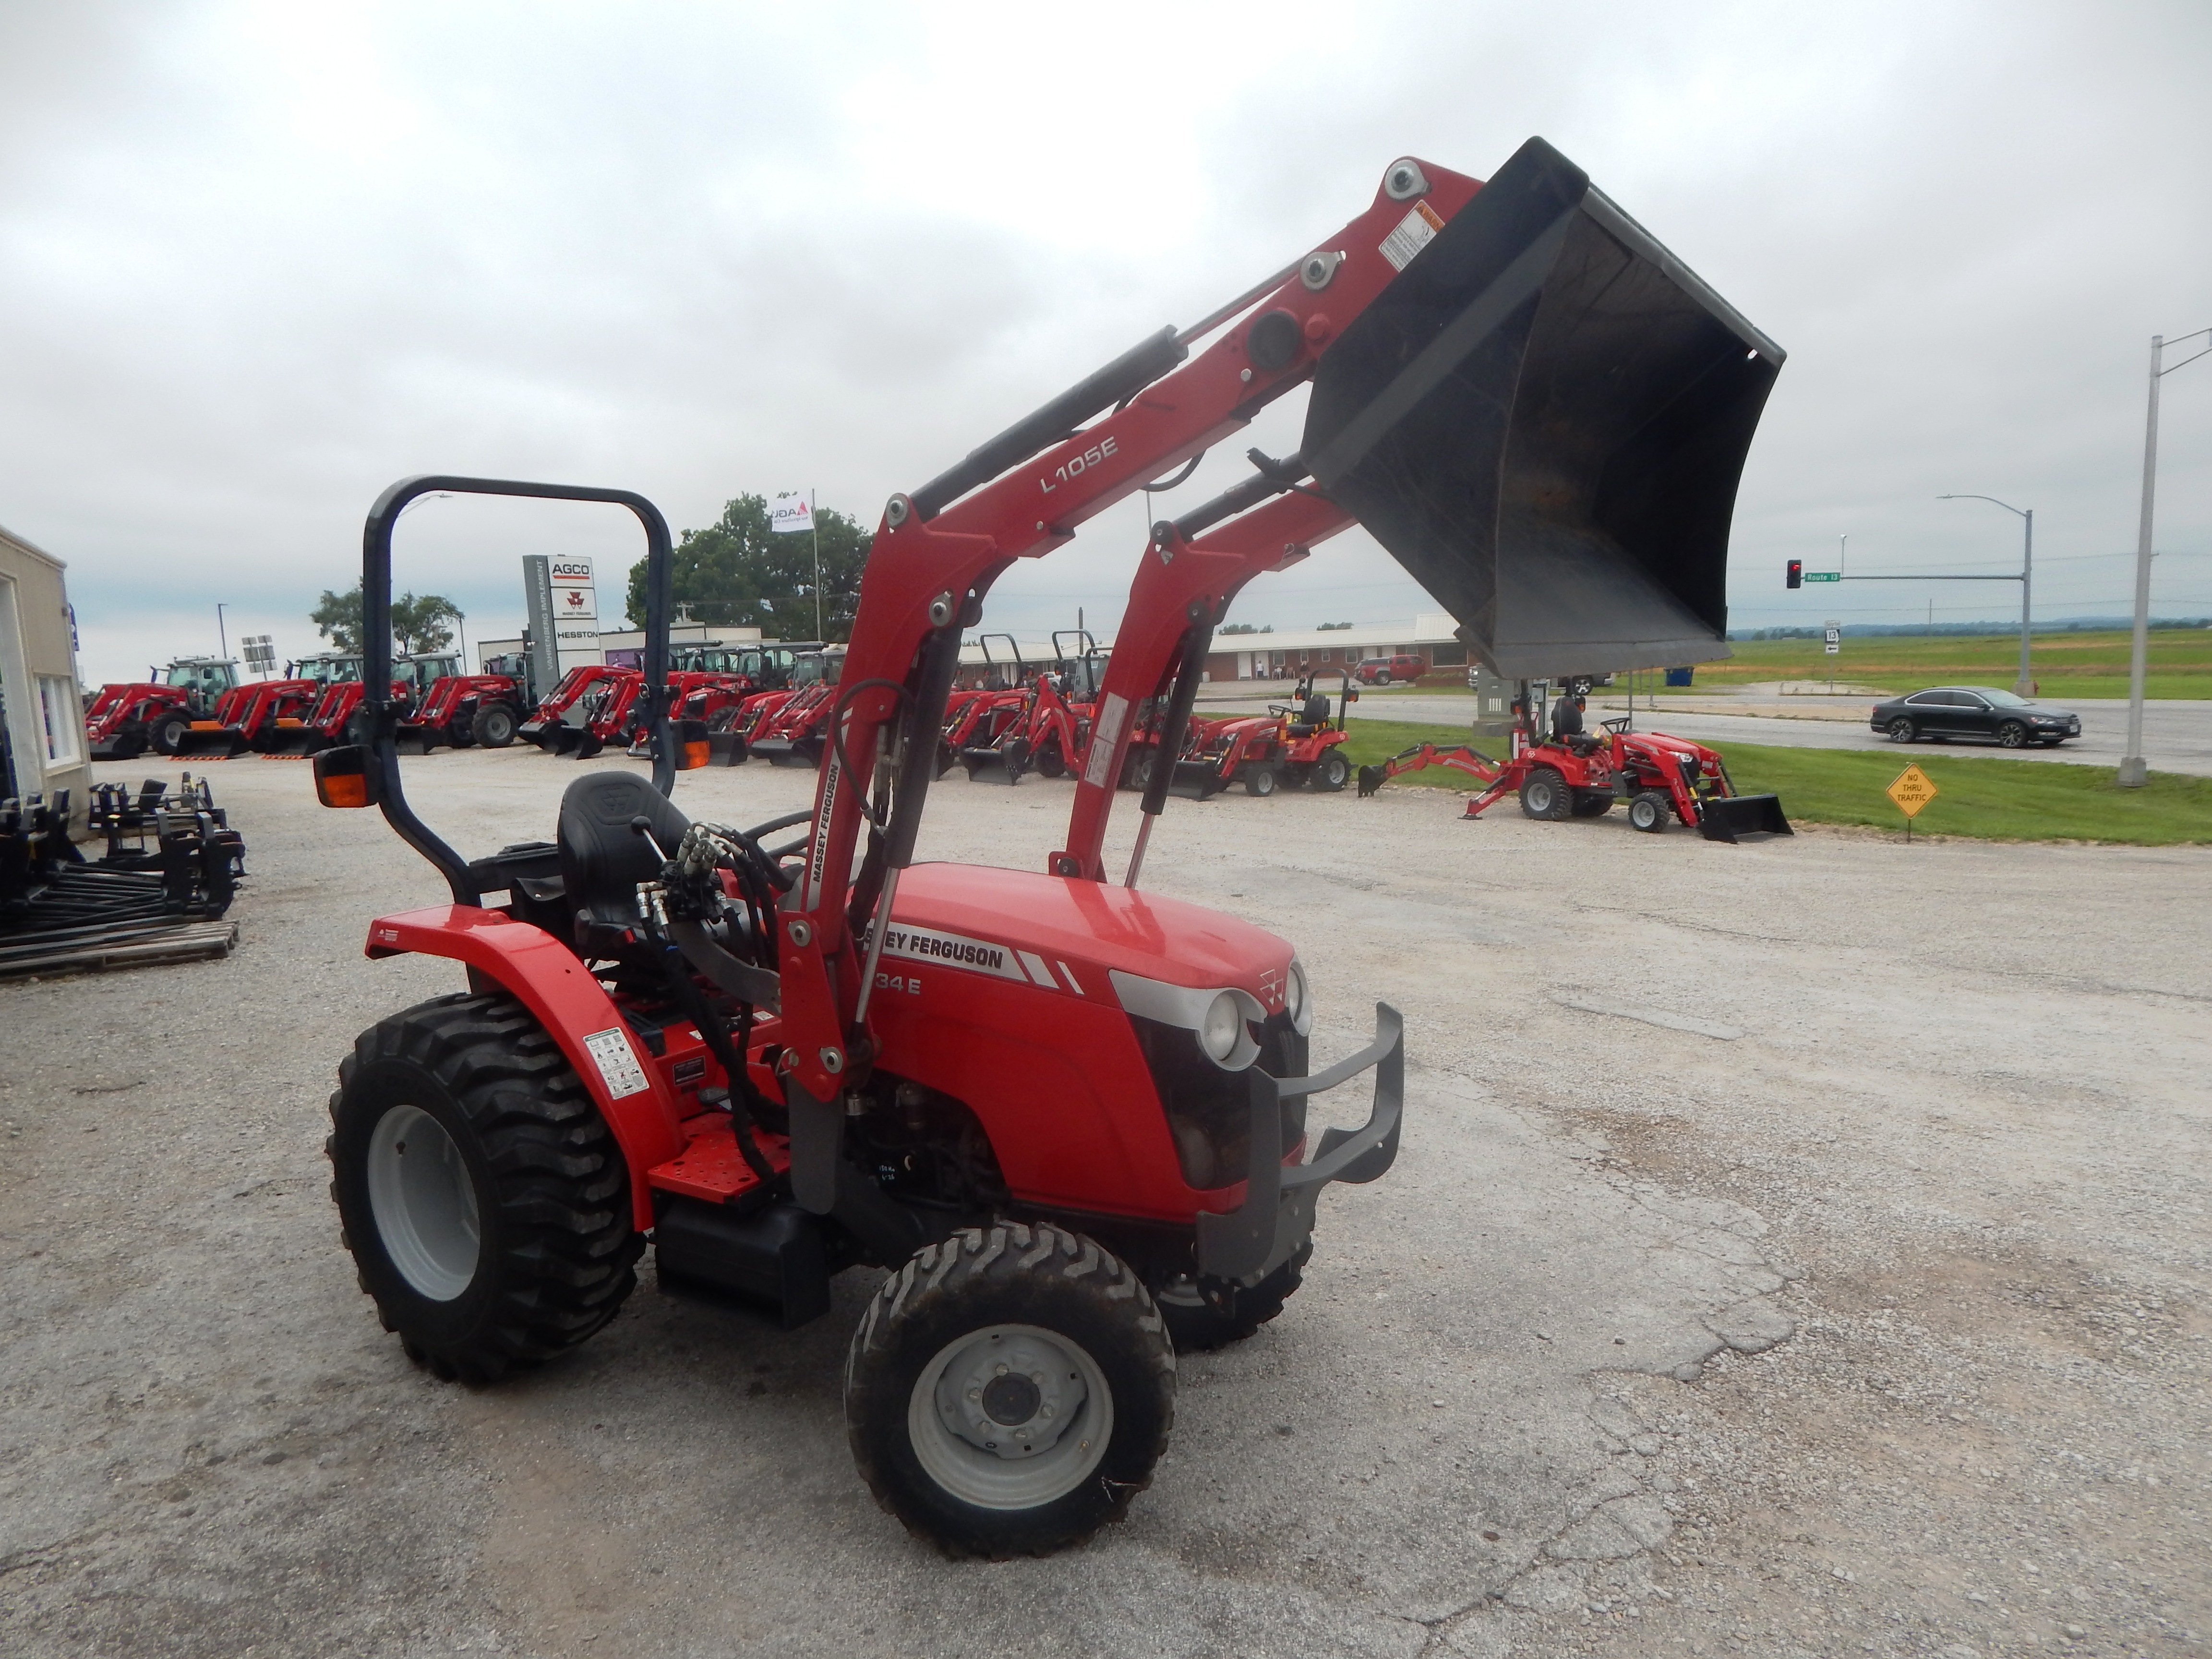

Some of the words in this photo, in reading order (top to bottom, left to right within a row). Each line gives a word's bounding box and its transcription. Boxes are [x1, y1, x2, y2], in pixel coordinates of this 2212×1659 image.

[1423, 211, 1441, 231] WARN
[1040, 436, 1118, 493] L105E
[536, 560, 548, 610] IMPLEMENT
[552, 564, 590, 575] AGCO
[542, 613, 553, 670] VAHRENBERG
[1829, 631, 1836, 639] 13
[813, 831, 826, 882] MASSEY
[820, 764, 838, 829] FERGUSON
[910, 935, 1003, 969] FERGUSON
